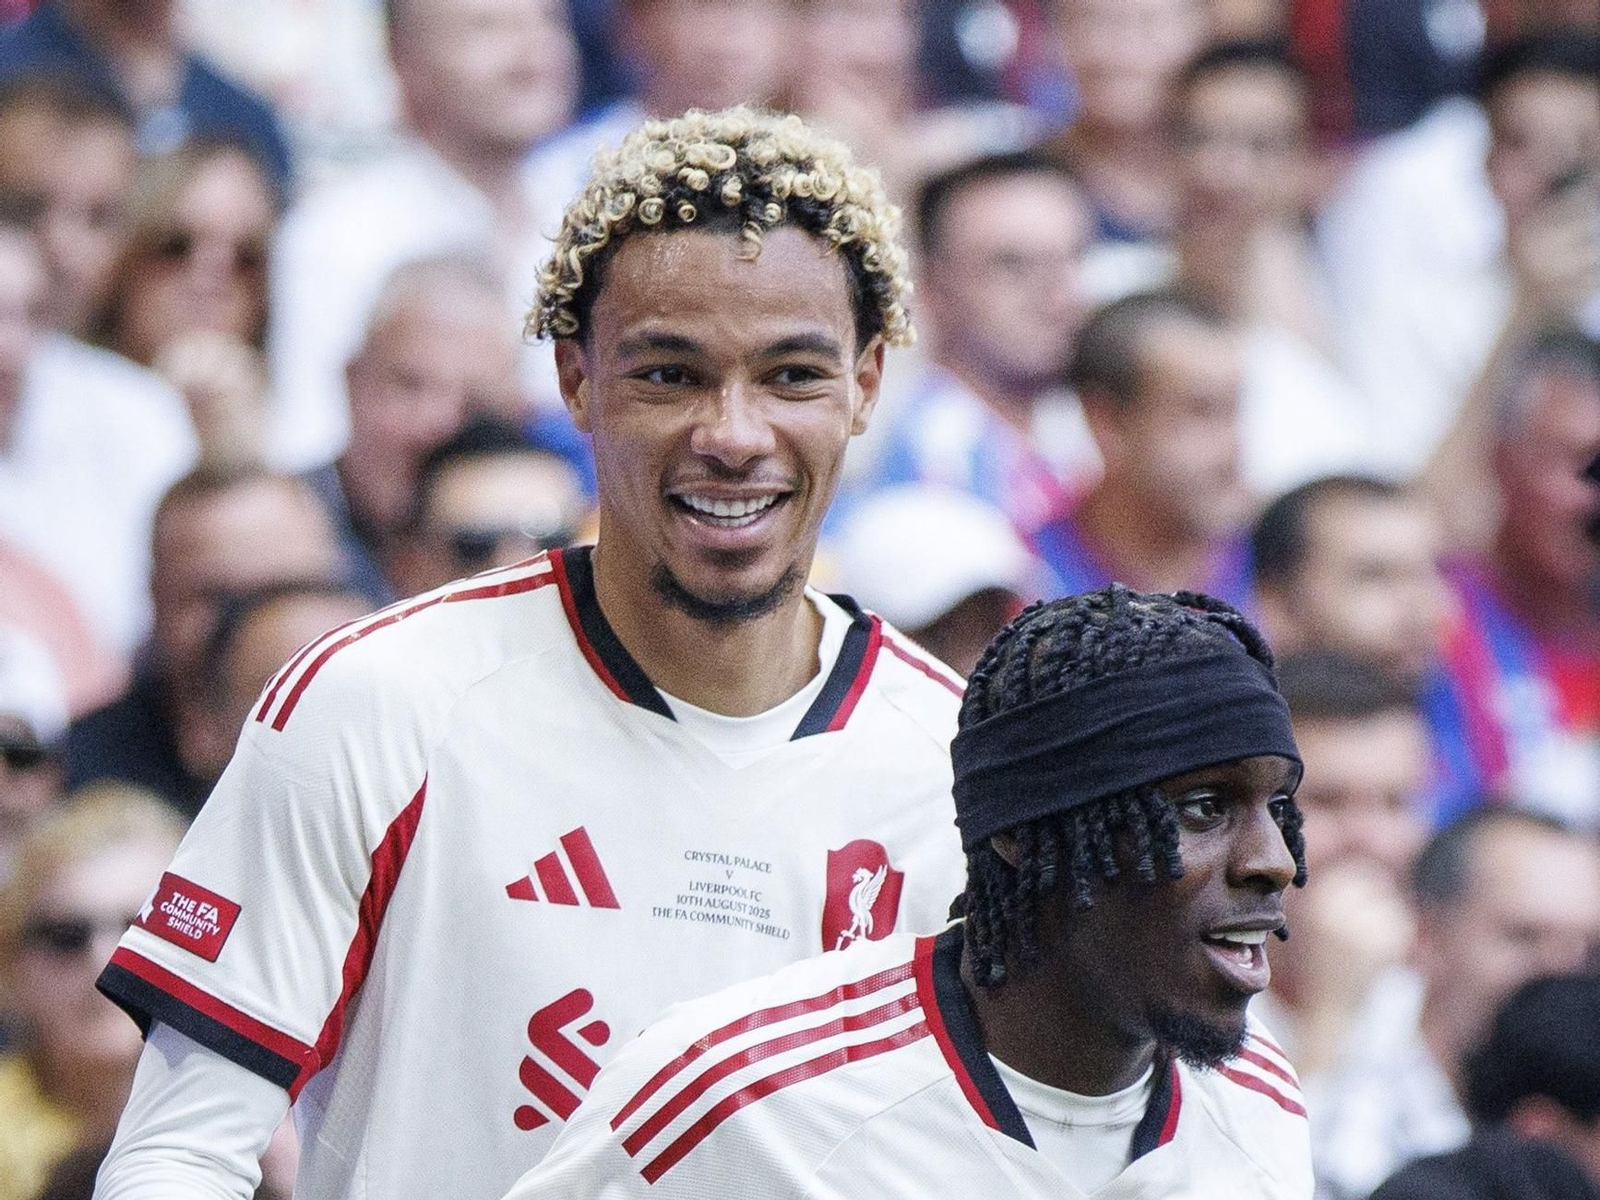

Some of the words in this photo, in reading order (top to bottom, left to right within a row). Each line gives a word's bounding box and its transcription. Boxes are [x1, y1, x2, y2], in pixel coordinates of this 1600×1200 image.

[684, 850, 733, 866] CRYSTAL
[734, 856, 772, 873] PALACE
[726, 870, 733, 879] V
[689, 881, 749, 899] LIVERPOOL
[750, 890, 762, 902] FC
[160, 901, 221, 936] COMMUNITY
[170, 891, 197, 913] THE
[196, 902, 219, 924] FA
[677, 894, 703, 907] 10TH
[705, 899, 747, 913] AUGUST
[749, 906, 771, 919] 2025
[167, 916, 202, 940] SHIELD
[652, 907, 673, 918] THE
[675, 909, 687, 920] FA
[690, 911, 755, 930] COMMUNITY
[756, 923, 790, 940] SHIELD
